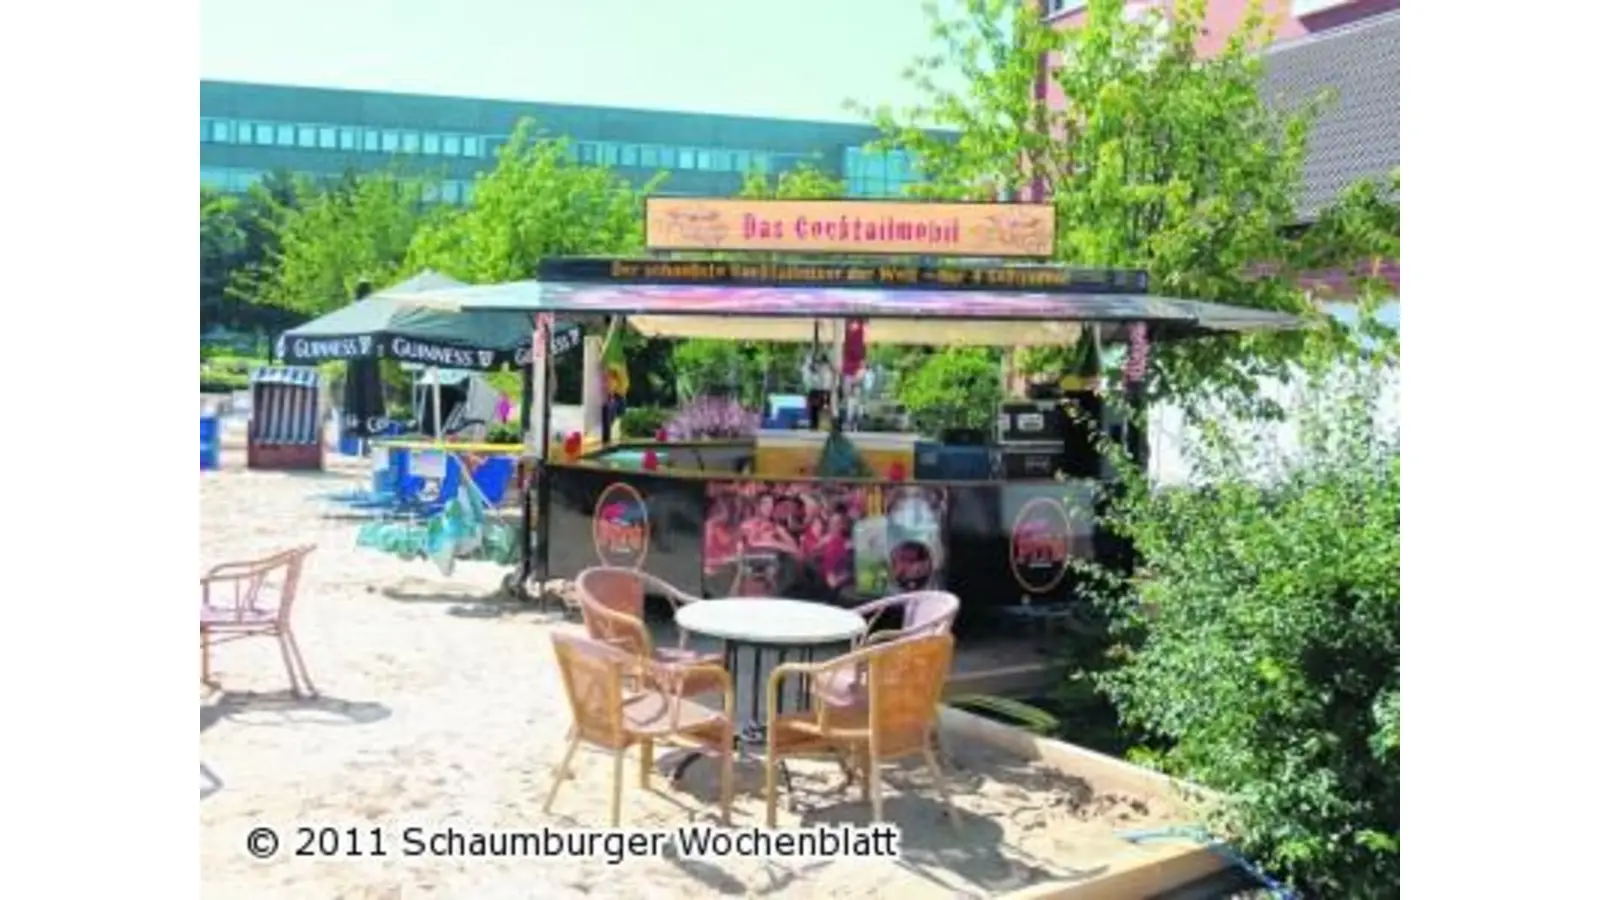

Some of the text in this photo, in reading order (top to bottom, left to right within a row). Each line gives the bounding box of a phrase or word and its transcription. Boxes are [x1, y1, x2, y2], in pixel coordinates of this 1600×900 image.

[743, 212, 784, 241] Das
[293, 338, 356, 359] GUINNESS
[391, 337, 473, 367] GUINNESS
